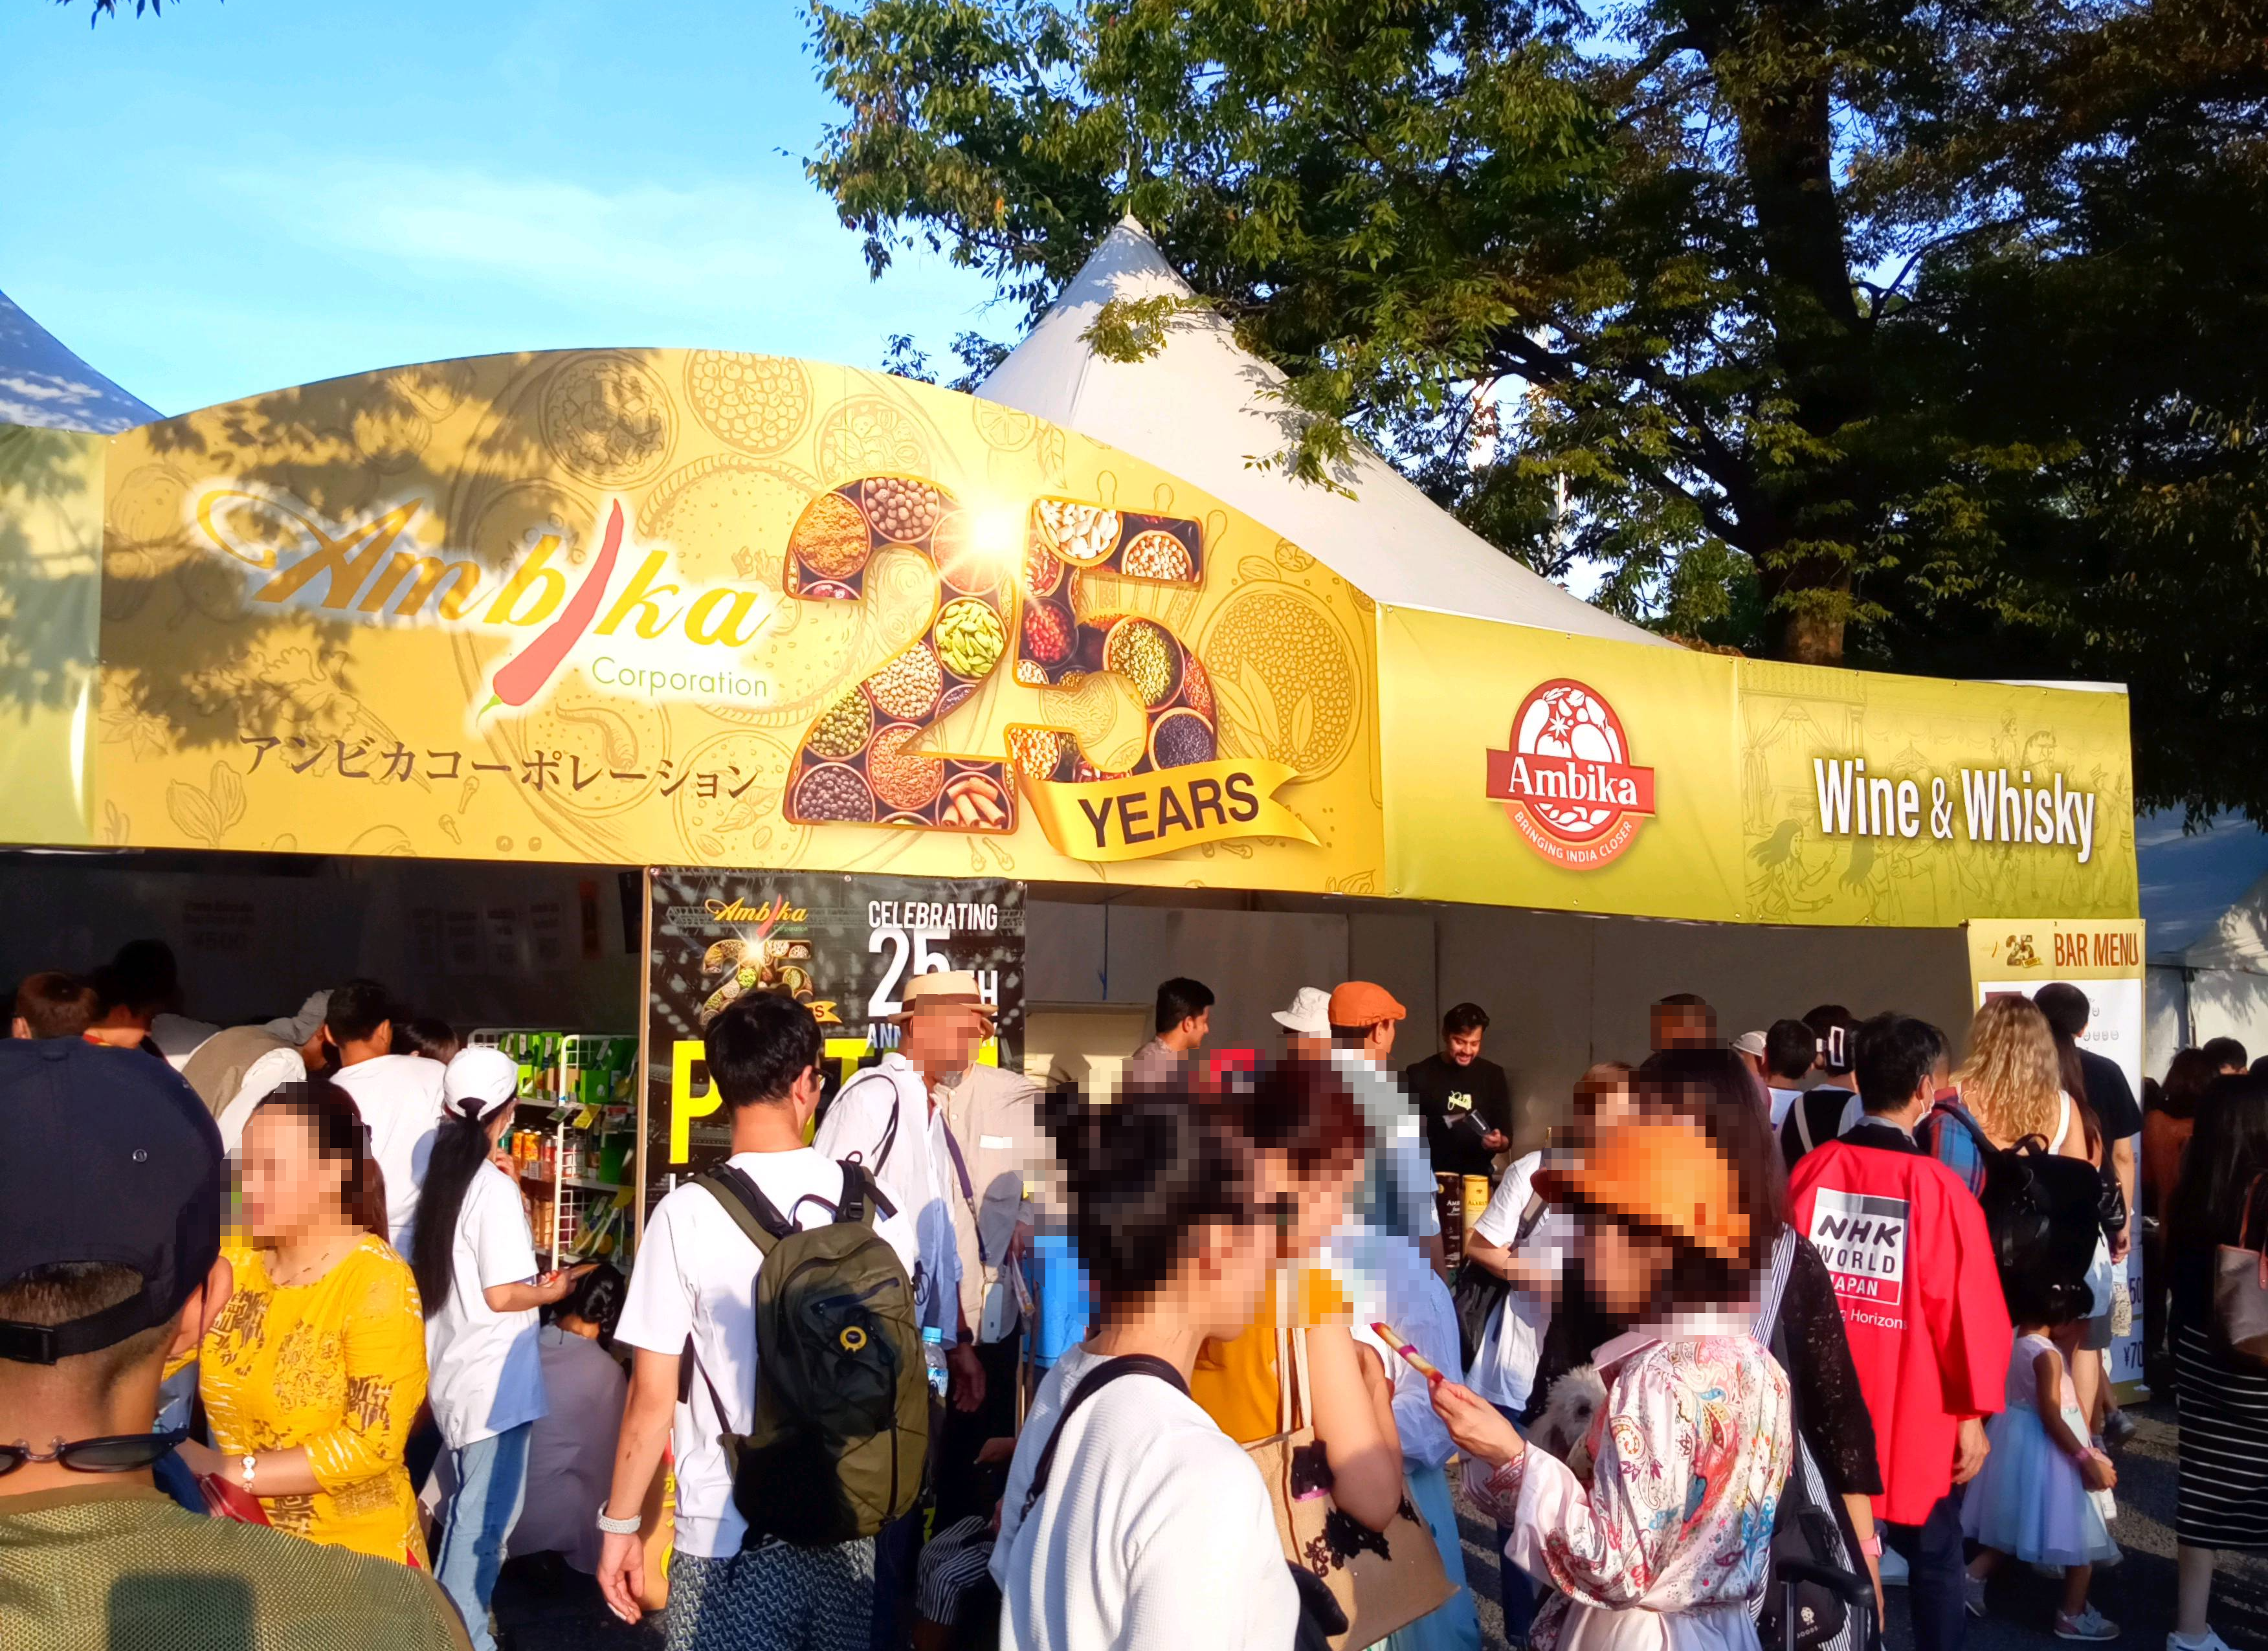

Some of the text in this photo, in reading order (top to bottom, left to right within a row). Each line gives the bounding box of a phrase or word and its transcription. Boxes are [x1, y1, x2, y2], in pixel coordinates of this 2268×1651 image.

[783, 471, 1218, 834] 25
[592, 657, 766, 697] Corporation
[239, 733, 759, 799] アンビカコーポレーション
[1508, 757, 1638, 805] Ambika
[1078, 772, 1259, 848] YEARS
[1813, 758, 2095, 863] Wine & Whisky
[1514, 810, 1632, 863] BRINGING INDIA CLOSER
[869, 900, 998, 930] CELEBRATING
[2006, 935, 2034, 966] 25
[2054, 933, 2139, 966] BAR MENU
[1818, 1215, 1902, 1248] NHK
[1817, 1243, 1895, 1274] WORLD
